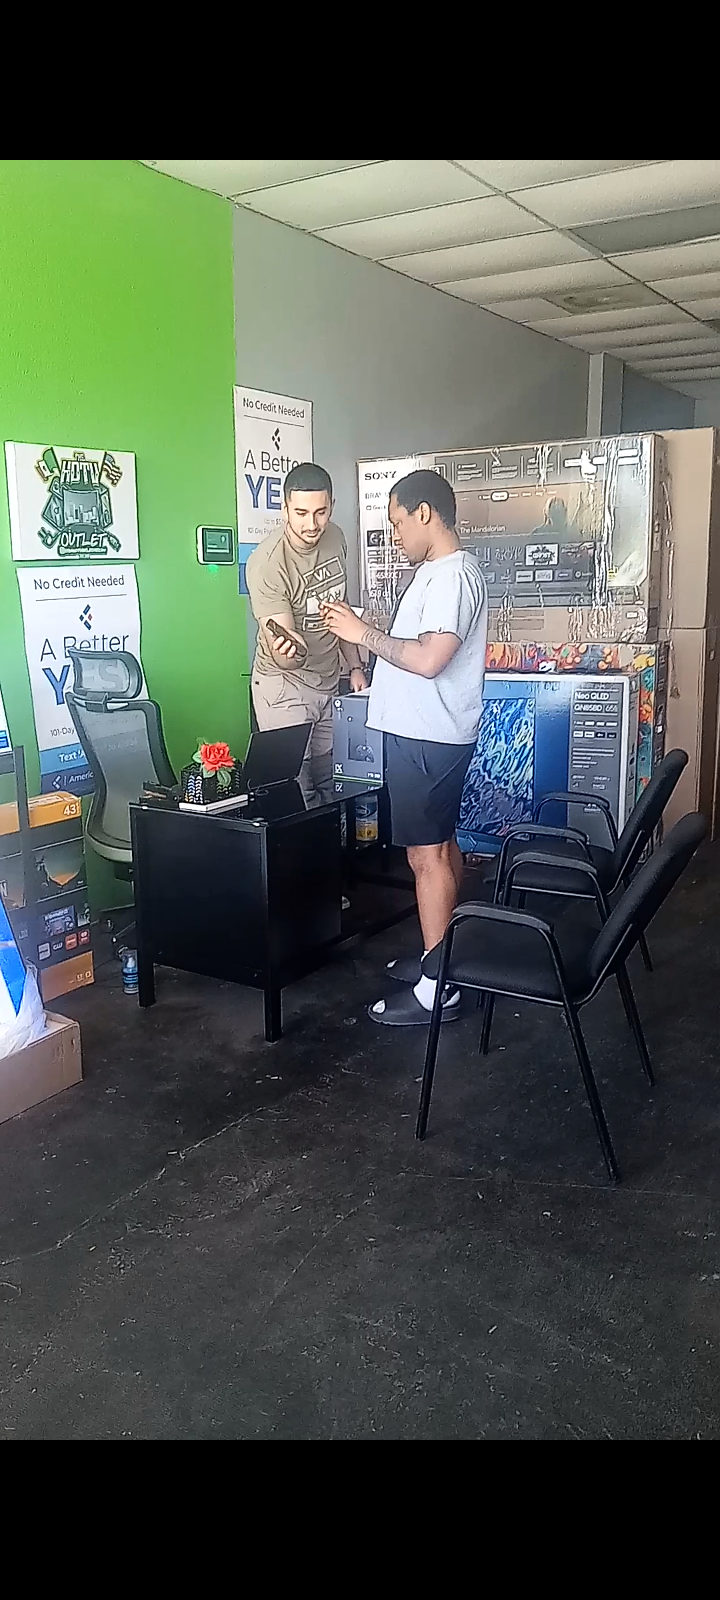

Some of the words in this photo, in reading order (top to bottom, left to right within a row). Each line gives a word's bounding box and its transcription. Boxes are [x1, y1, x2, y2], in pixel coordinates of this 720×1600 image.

[243, 398, 254, 409] No
[255, 401, 277, 414] Credit
[278, 405, 305, 418] Needed
[244, 449, 257, 469] A
[261, 451, 304, 473] Bette
[61, 460, 100, 485] HDTV
[365, 470, 397, 481] SONY
[245, 474, 282, 510] YE
[471, 524, 506, 533] Mandalorian
[60, 532, 108, 549] OUTLET
[34, 579, 50, 590] No
[52, 576, 86, 589] Credit
[87, 574, 125, 588] Needed
[40, 638, 57, 662] A
[574, 691, 589, 700] Neo
[590, 692, 610, 700] QLED
[59, 752, 77, 763] Text
[69, 770, 94, 784] Americ
